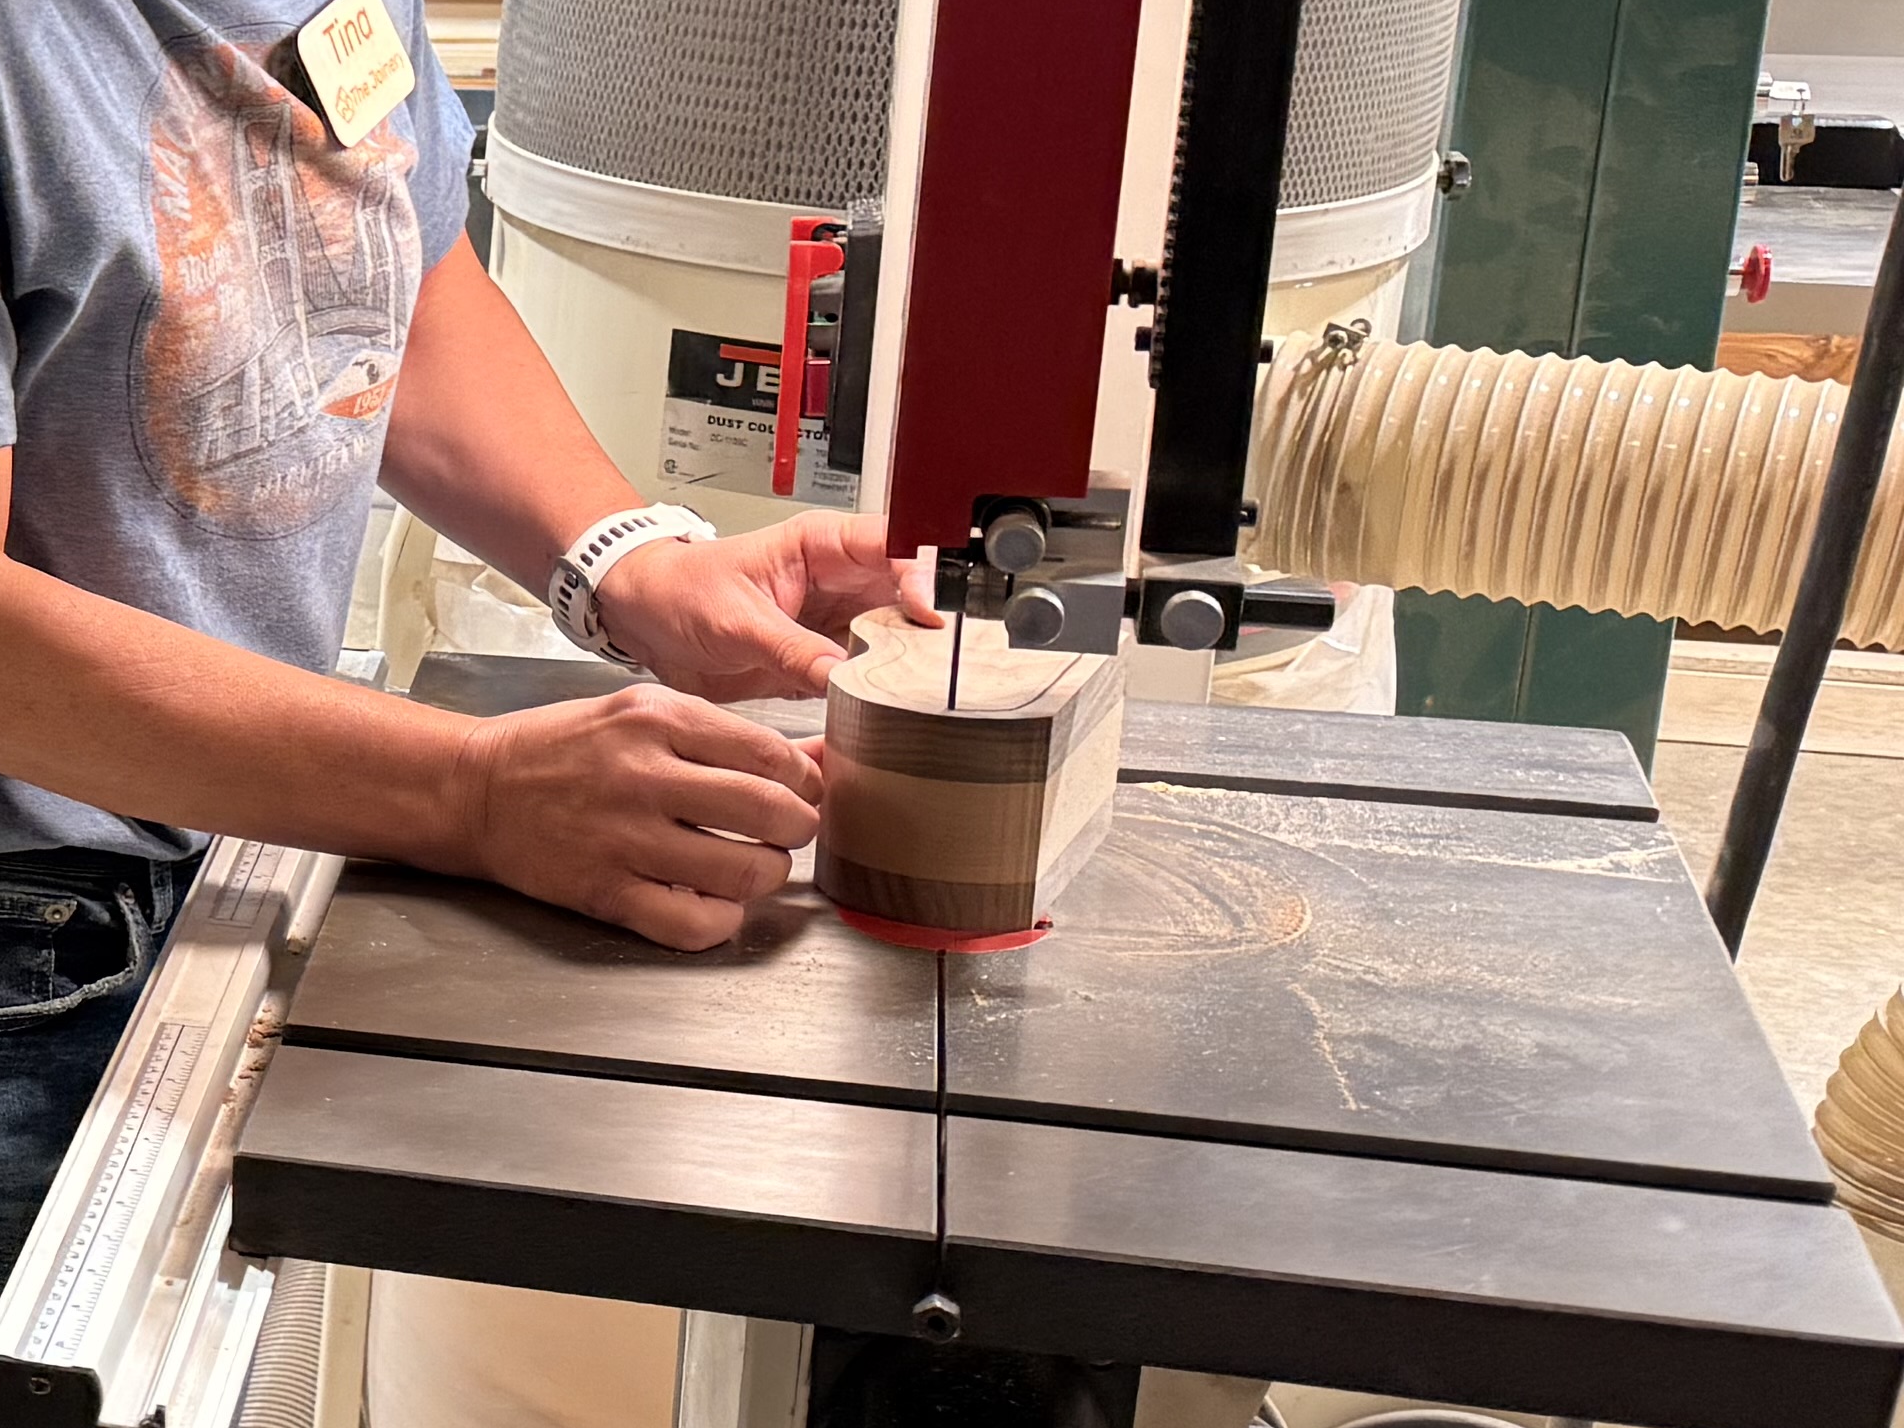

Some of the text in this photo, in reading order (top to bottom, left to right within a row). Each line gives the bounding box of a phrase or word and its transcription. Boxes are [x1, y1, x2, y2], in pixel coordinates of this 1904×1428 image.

[322, 7, 373, 65] Tina
[716, 362, 781, 394] JE
[707, 414, 744, 430] DUST
